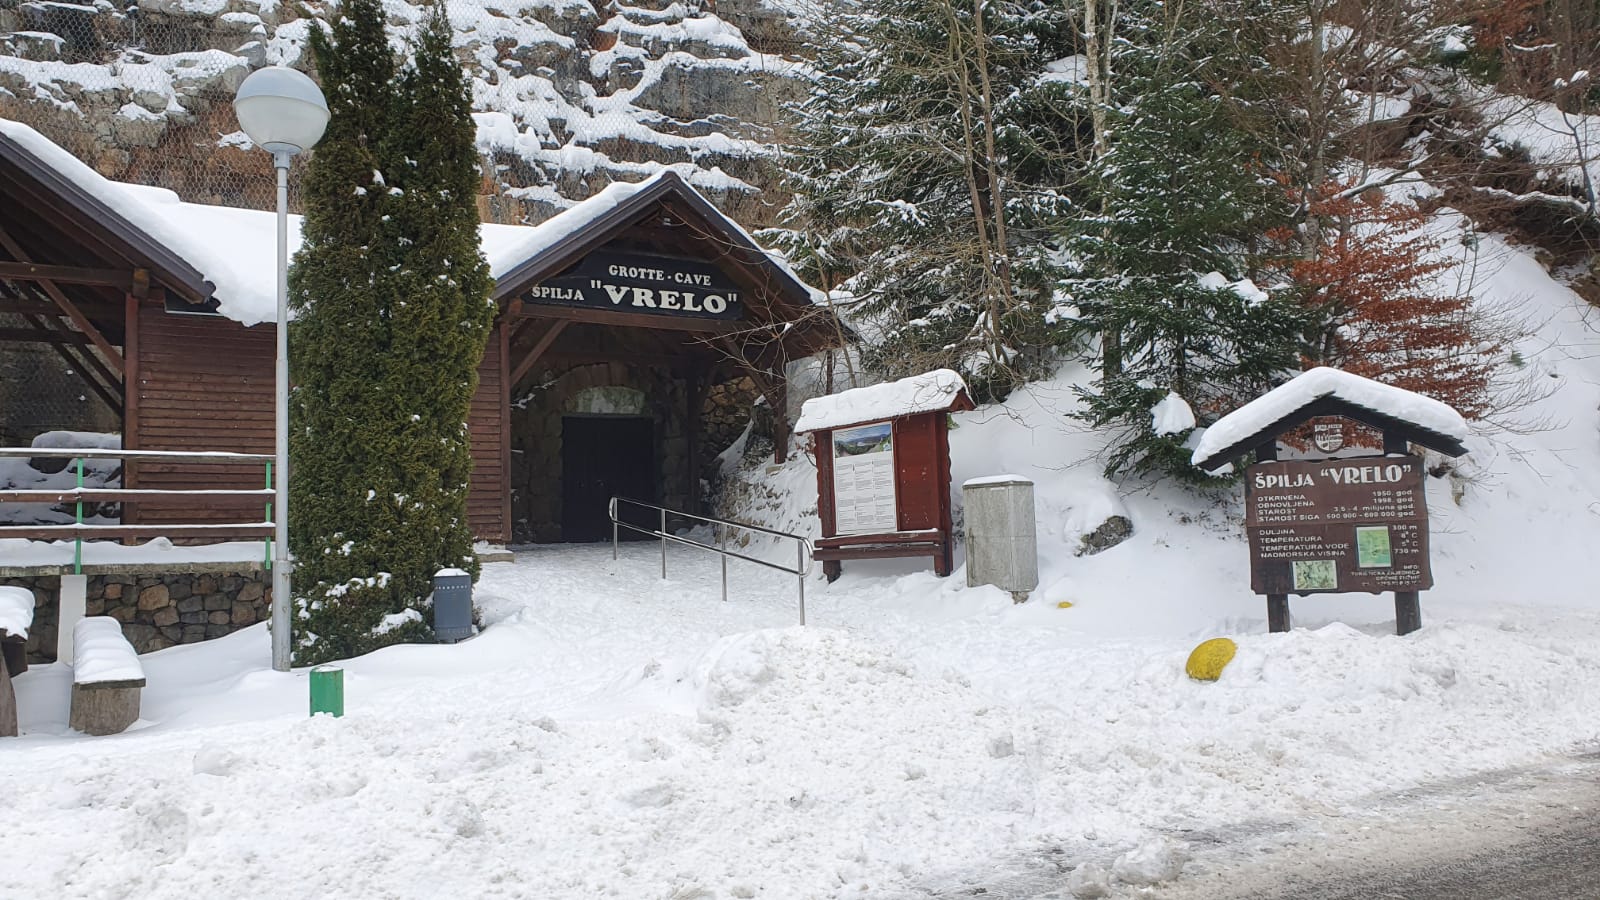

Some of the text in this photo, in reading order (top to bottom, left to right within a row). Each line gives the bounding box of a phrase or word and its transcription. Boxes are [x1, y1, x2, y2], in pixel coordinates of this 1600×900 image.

[609, 264, 664, 280] GROTTE
[675, 273, 711, 286] CAVE
[591, 280, 737, 314] "VRELO"
[1255, 472, 1315, 488] ŠPILJA
[1258, 494, 1306, 502] OTKRIVENA
[1258, 501, 1315, 509] OBNOVLJENA
[1260, 536, 1322, 544] TEMPERATURA
